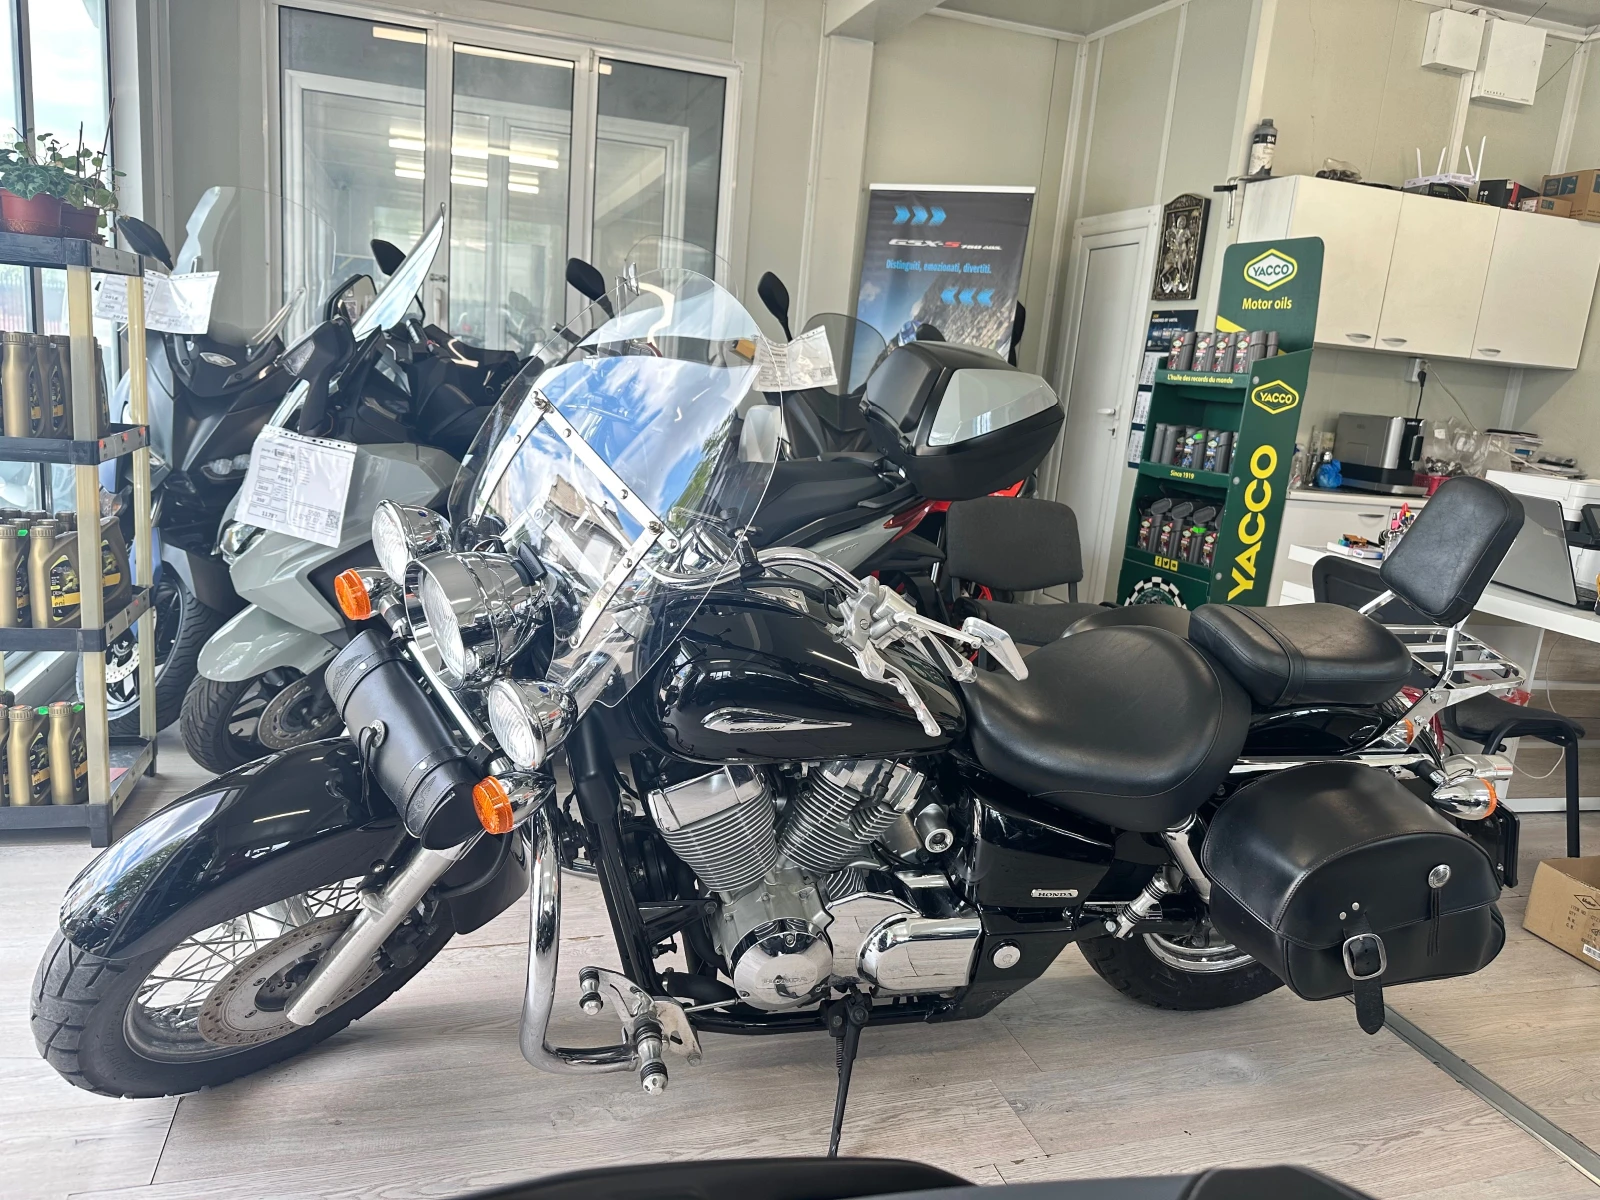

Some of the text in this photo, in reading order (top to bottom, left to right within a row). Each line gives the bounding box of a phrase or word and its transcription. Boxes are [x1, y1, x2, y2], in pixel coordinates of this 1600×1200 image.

[923, 261, 961, 273] emozionati,
[1252, 264, 1290, 277] YACCO
[1242, 297, 1293, 310] Motor oils
[1167, 373, 1182, 381] L'huile
[1259, 391, 1293, 404] YACCO
[1170, 469, 1195, 479] Since 1919
[1227, 444, 1278, 601] YACCO
[763, 976, 808, 984] HONDA
